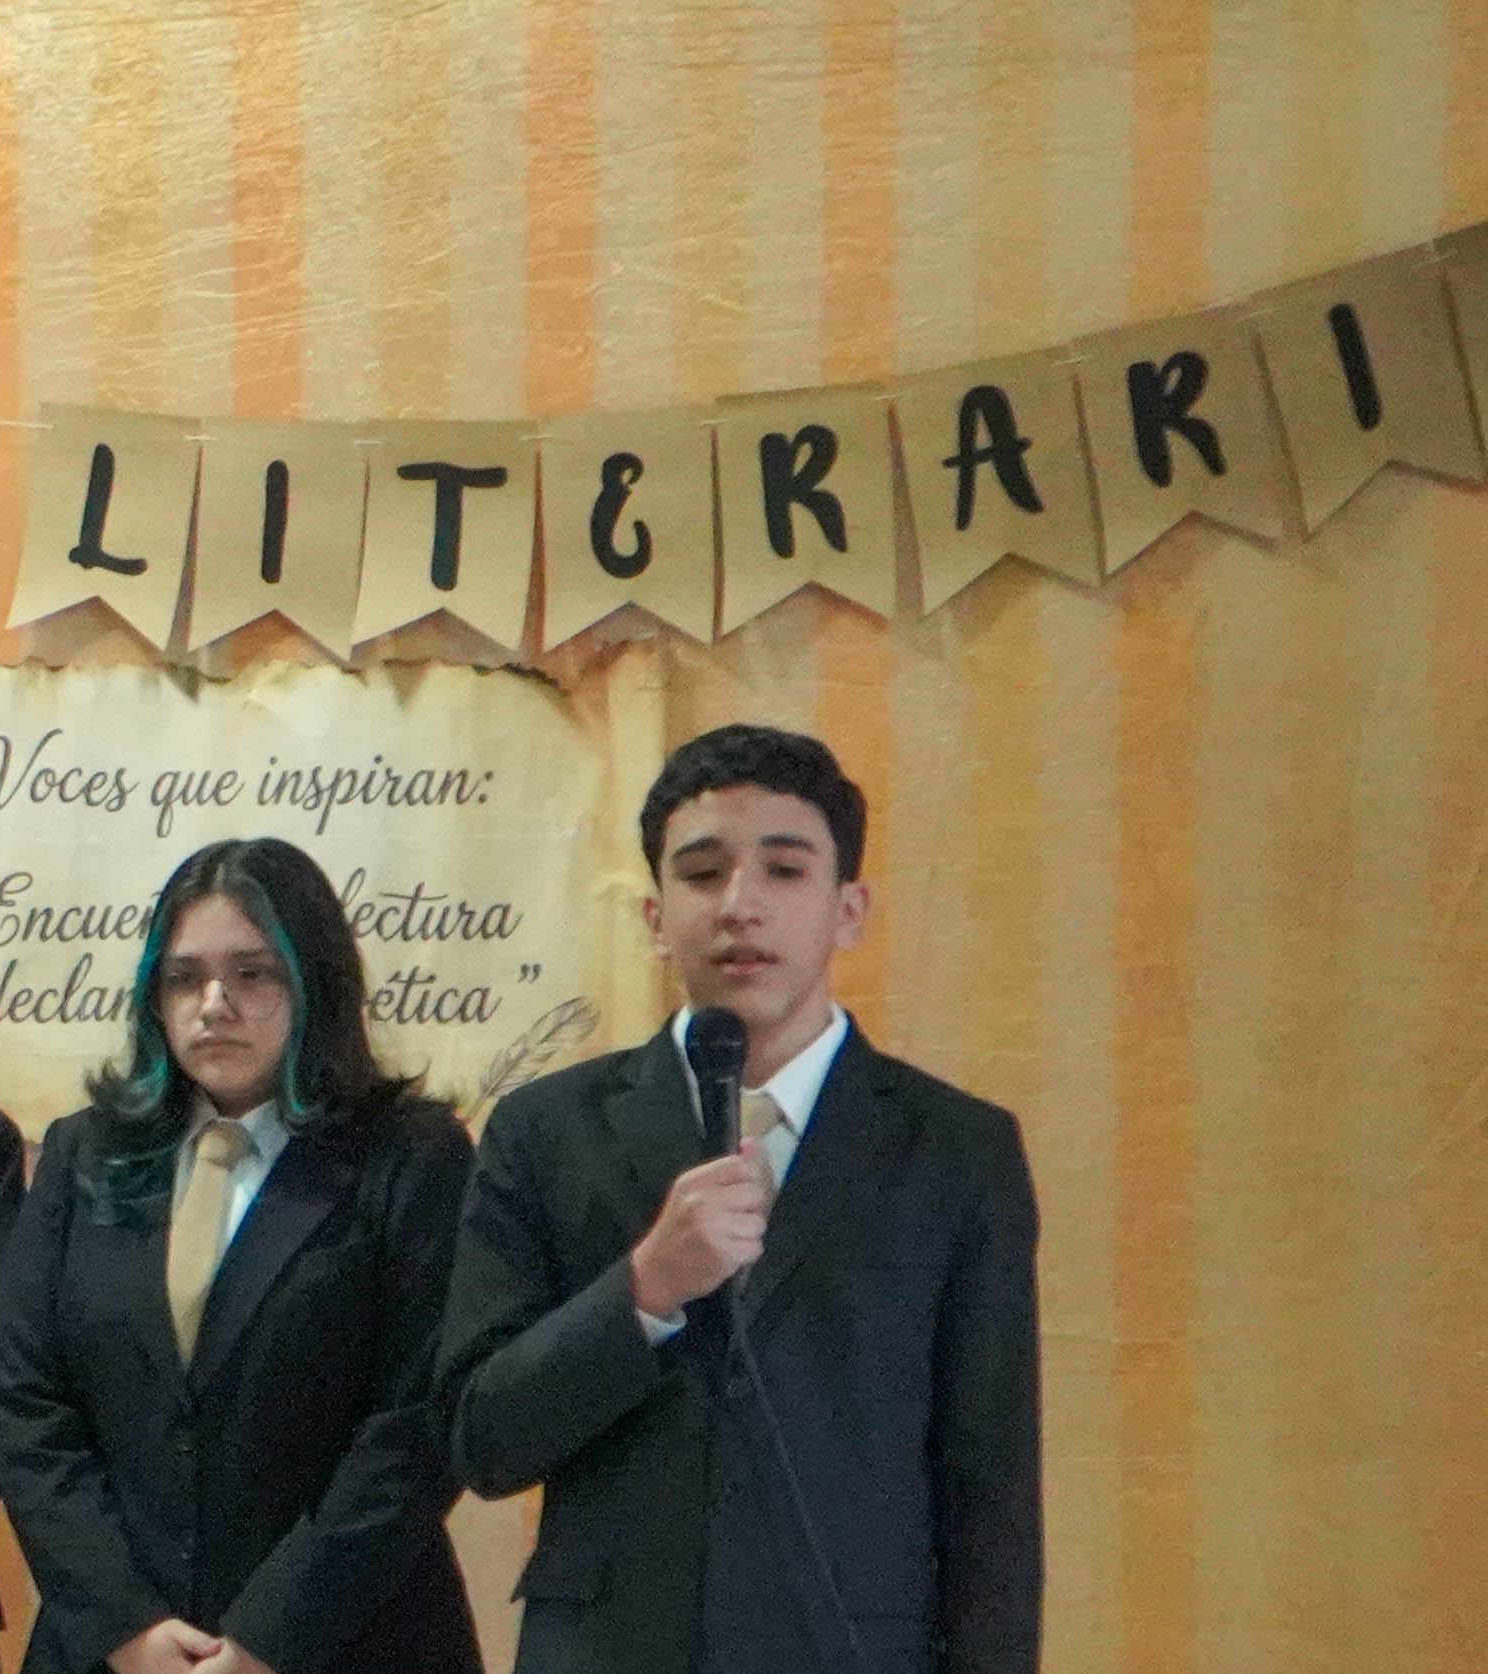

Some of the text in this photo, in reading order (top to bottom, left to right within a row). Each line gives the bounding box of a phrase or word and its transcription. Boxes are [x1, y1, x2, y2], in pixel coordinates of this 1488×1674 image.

[66, 302, 1383, 592] LITERARI
[150, 767, 245, 838] que
[256, 754, 494, 836] inspiran:
